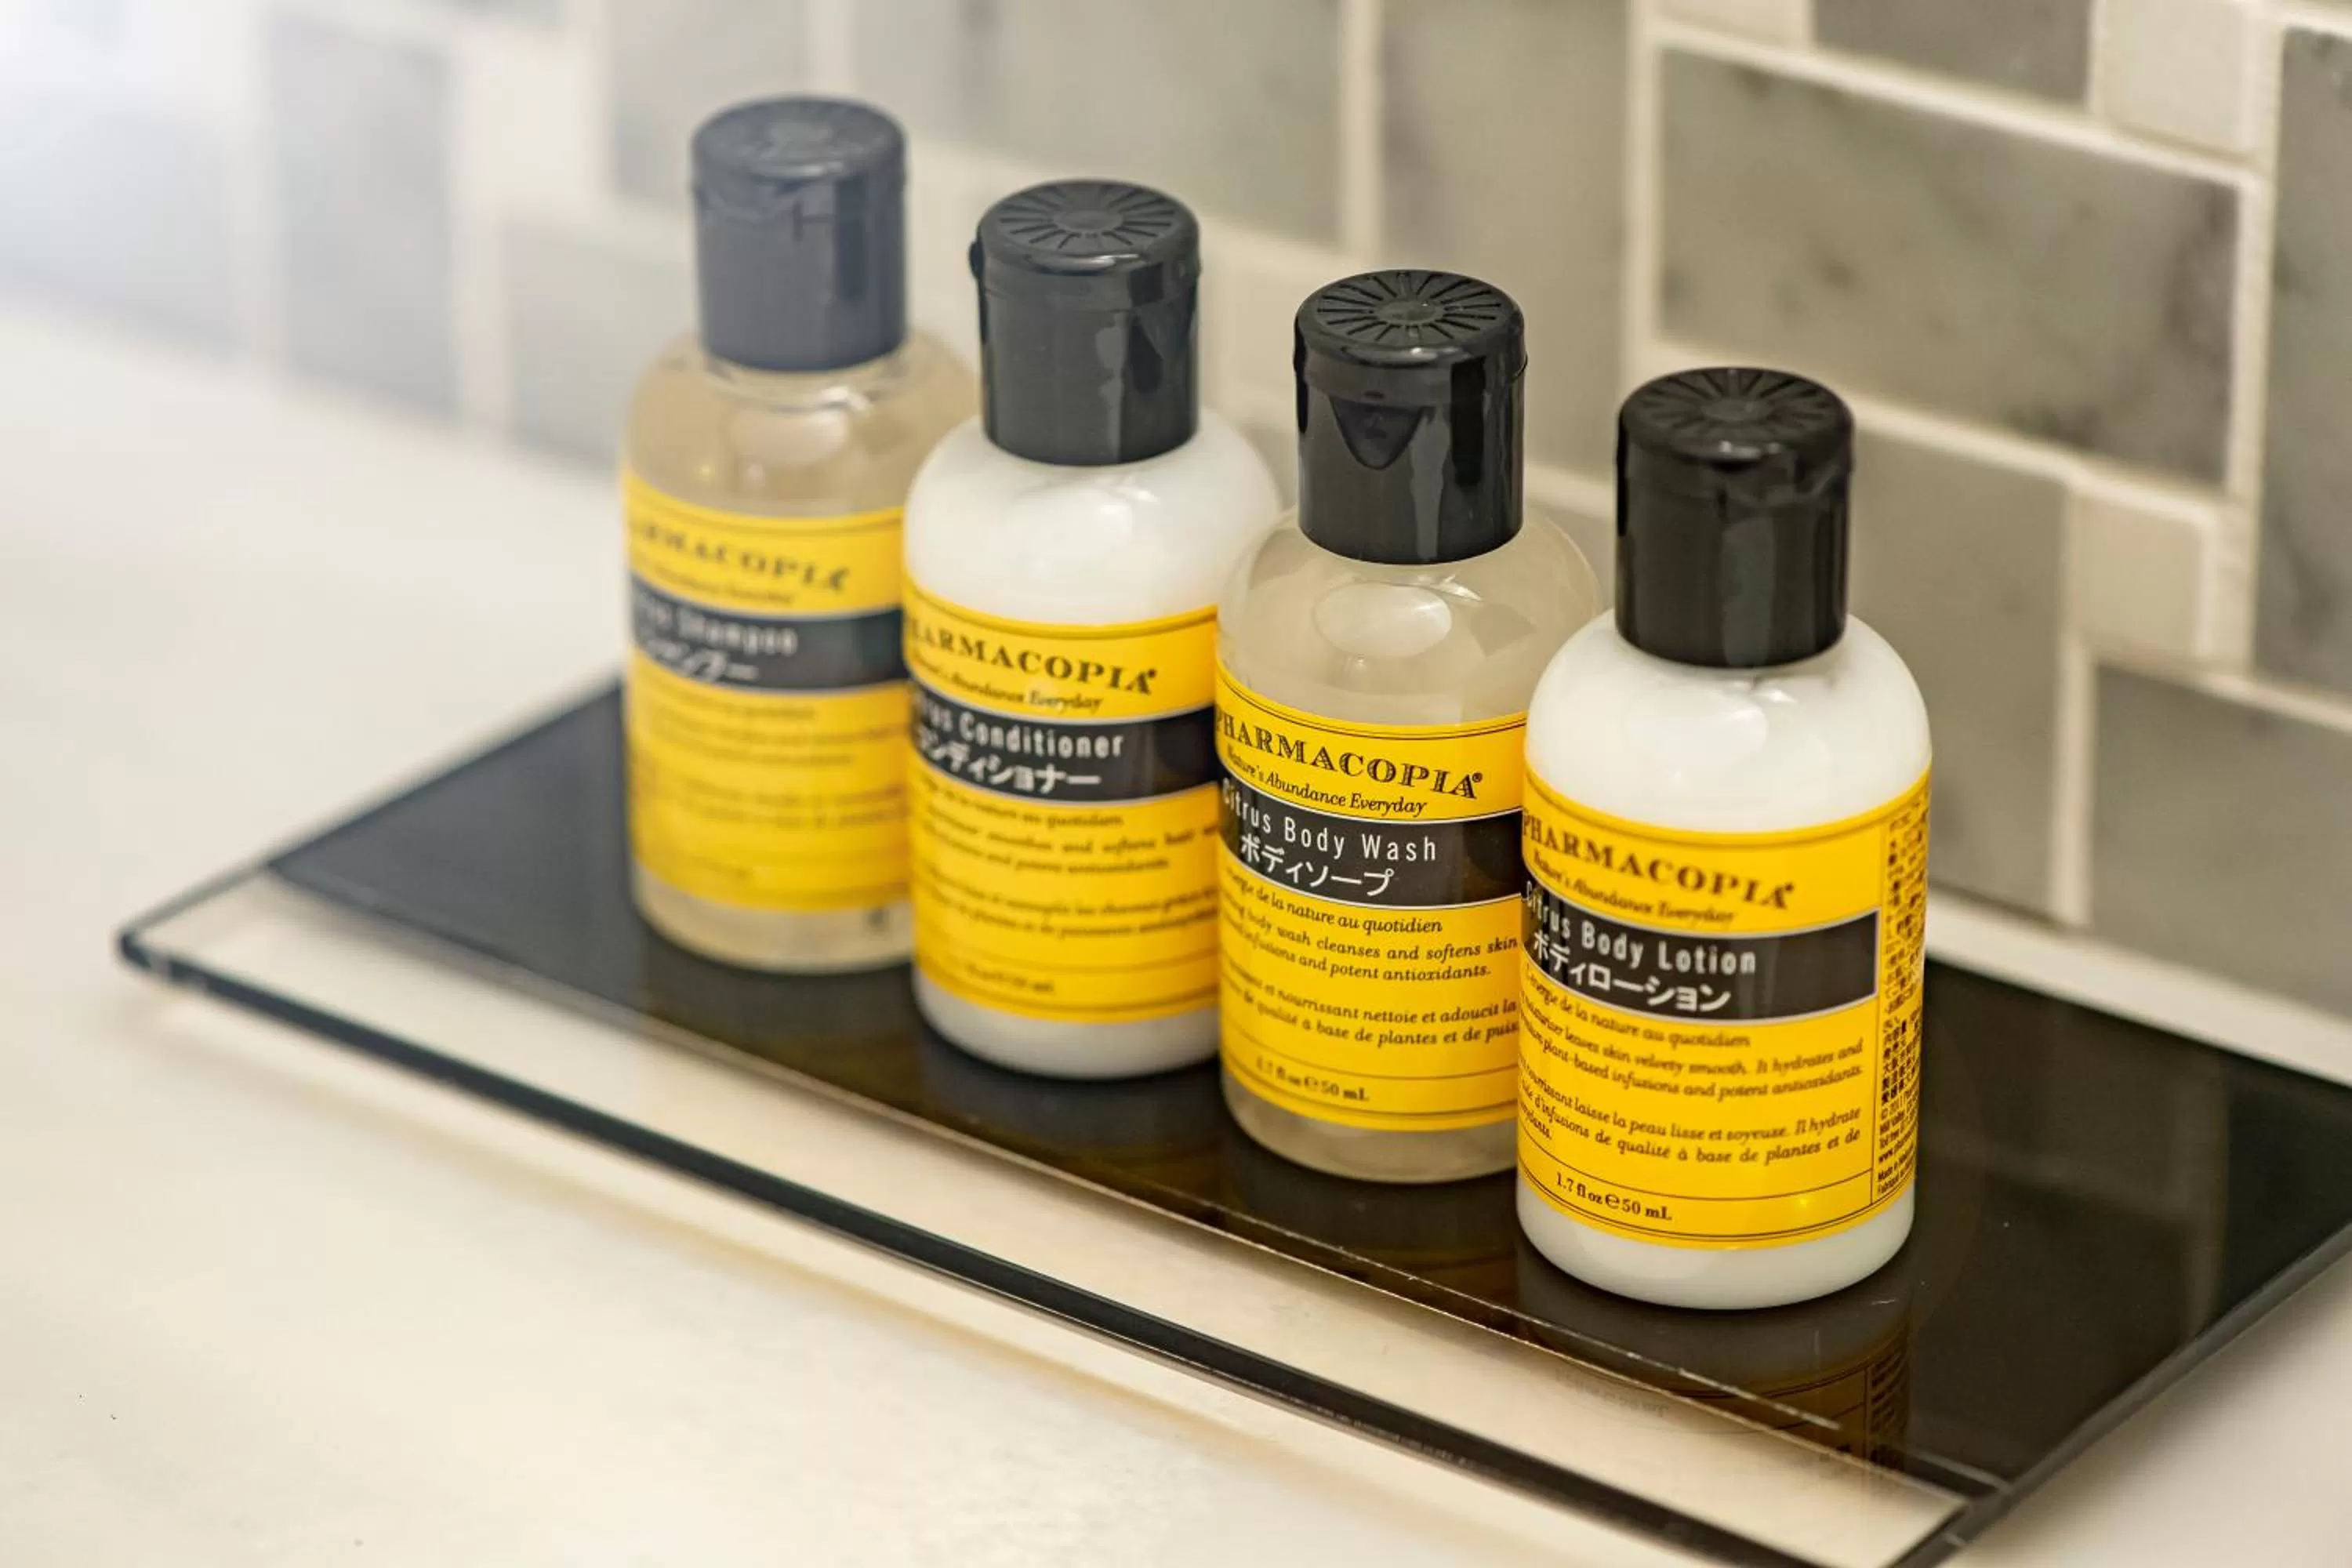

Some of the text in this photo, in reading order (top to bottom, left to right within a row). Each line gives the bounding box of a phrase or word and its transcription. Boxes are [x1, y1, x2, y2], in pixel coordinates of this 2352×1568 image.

[958, 710, 1124, 759] Conditioner
[1265, 771, 1347, 807] Abundance
[1349, 792, 1428, 818] Everyday
[1223, 777, 1436, 862] Citrus Body Wash
[1241, 833, 1395, 897] ボディソープ
[1286, 902, 1335, 925] nature
[1338, 916, 1360, 929] au
[1362, 916, 1443, 936] quotidien
[1526, 880, 1756, 975] Citrus Body Lotion
[1276, 926, 1311, 946] wash
[1316, 935, 1381, 958] cleanses
[1386, 945, 1421, 960] and
[1426, 943, 1481, 964] softens
[1486, 936, 1518, 954] skin
[1298, 956, 1327, 971] and
[1329, 963, 1379, 978] potent
[1382, 965, 1491, 981] antioxidants.
[1533, 928, 1731, 1014] ボディローション
[1363, 1010, 1418, 1024] nettoie
[1421, 1011, 1436, 1023] et
[1439, 1003, 1500, 1023] adoucit
[1503, 998, 1517, 1014] la
[1575, 1003, 1588, 1022] la
[1591, 1014, 1639, 1036] nature
[1642, 1028, 1664, 1042] au
[1316, 1020, 1350, 1040] base
[1354, 1026, 1374, 1043] de
[1377, 1029, 1438, 1049] plantes
[1443, 1031, 1457, 1044] et
[1462, 1025, 1482, 1042] de
[1772, 1053, 1834, 1077] hydrates
[1837, 1036, 1864, 1060] and
[1682, 1081, 1716, 1096] and
[1716, 1084, 1768, 1104] potent
[1573, 1097, 1611, 1123] laisse
[1613, 1110, 1628, 1128] la
[1628, 1119, 1666, 1136] peau
[1670, 1122, 1705, 1141] lisse
[1708, 1128, 1722, 1142] et
[1808, 1106, 1861, 1137] hydrate
[1595, 1128, 1612, 1145] de
[1696, 1145, 1733, 1163] base
[1738, 1147, 1759, 1163] de
[1762, 1142, 1821, 1167] plantes
[1827, 1135, 1839, 1150] et
[1844, 1127, 1860, 1144] de
[1556, 1171, 1575, 1192] 1.7
[1576, 1181, 1587, 1199] fl
[1588, 1192, 1603, 1205] oz
[1621, 1198, 1641, 1214] 50
[1645, 1205, 1673, 1221] mL
